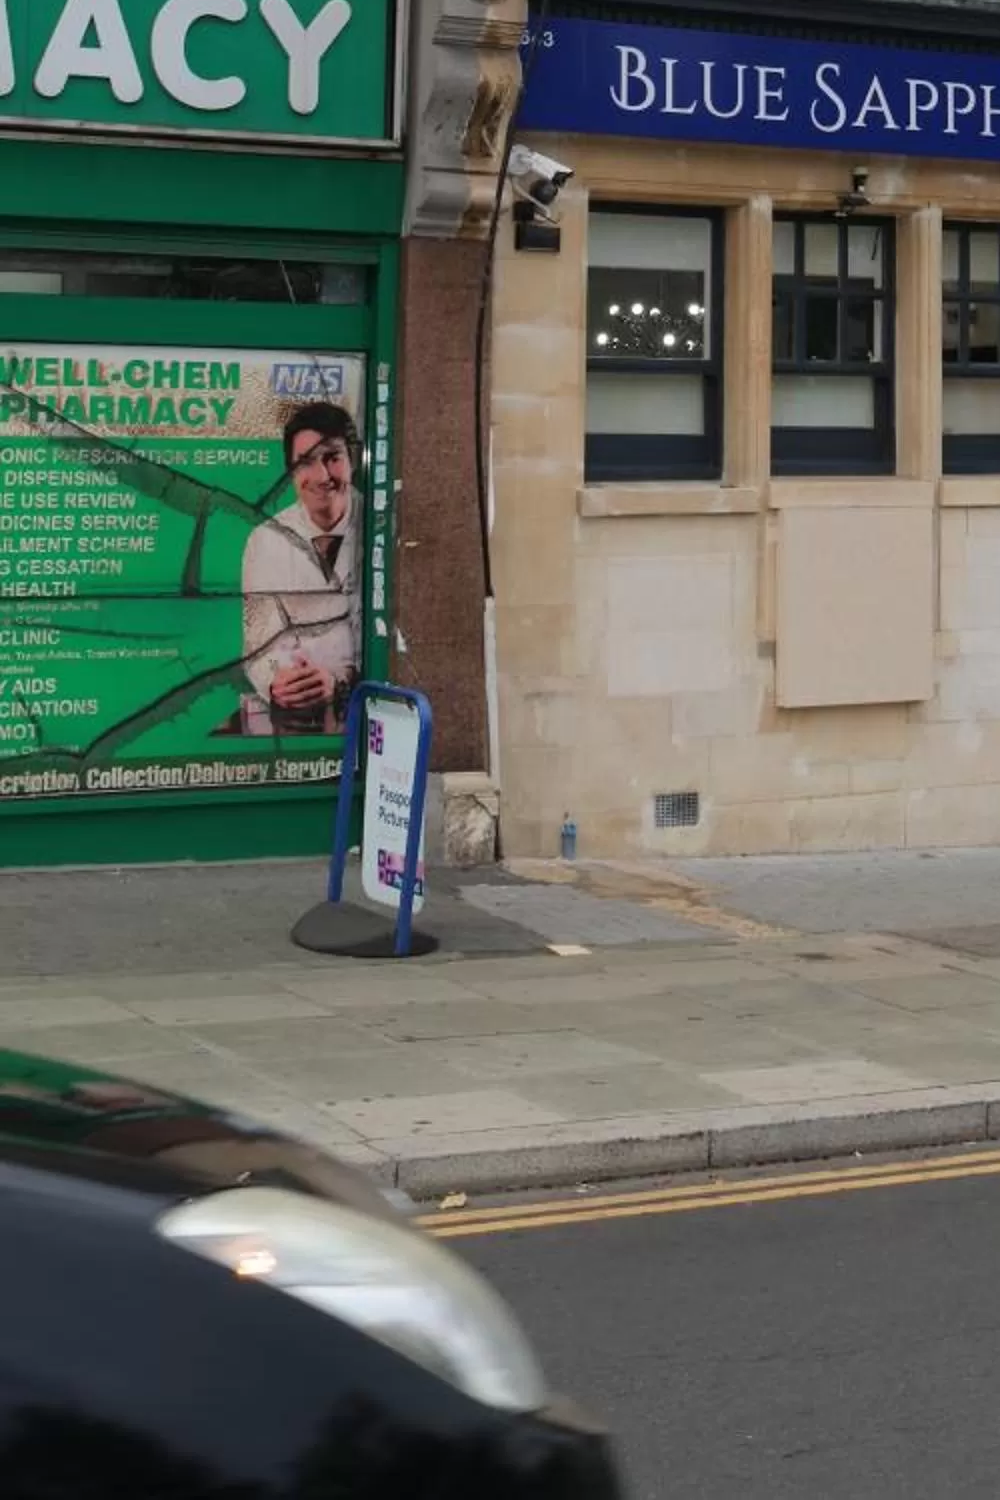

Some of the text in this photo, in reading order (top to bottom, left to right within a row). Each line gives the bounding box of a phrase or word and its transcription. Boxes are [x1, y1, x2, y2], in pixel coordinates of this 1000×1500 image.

[520, 30, 554, 47] 63
[609, 44, 789, 122] BLUE
[0, 356, 240, 390] WELL-CHEM
[276, 366, 341, 393] NHS
[0, 393, 236, 427] PHARMACY
[0, 448, 46, 465] ONIC
[193, 449, 269, 466] SERVICE
[5, 470, 118, 487] DISPENSING
[21, 492, 58, 509] USE
[64, 492, 136, 509] REVIEW
[0, 514, 160, 531] DICINES SERVICE
[0, 536, 155, 553] ILMENT SCHEME
[16, 559, 123, 575] CESSATION
[2, 581, 76, 597] HEALTH
[0, 630, 60, 646] CLINIC
[12, 678, 57, 695] AIDS
[0, 699, 97, 718] CINATIONS
[0, 770, 80, 794] cription
[86, 760, 269, 789] Collection/Delivery
[379, 784, 410, 808] Passpo
